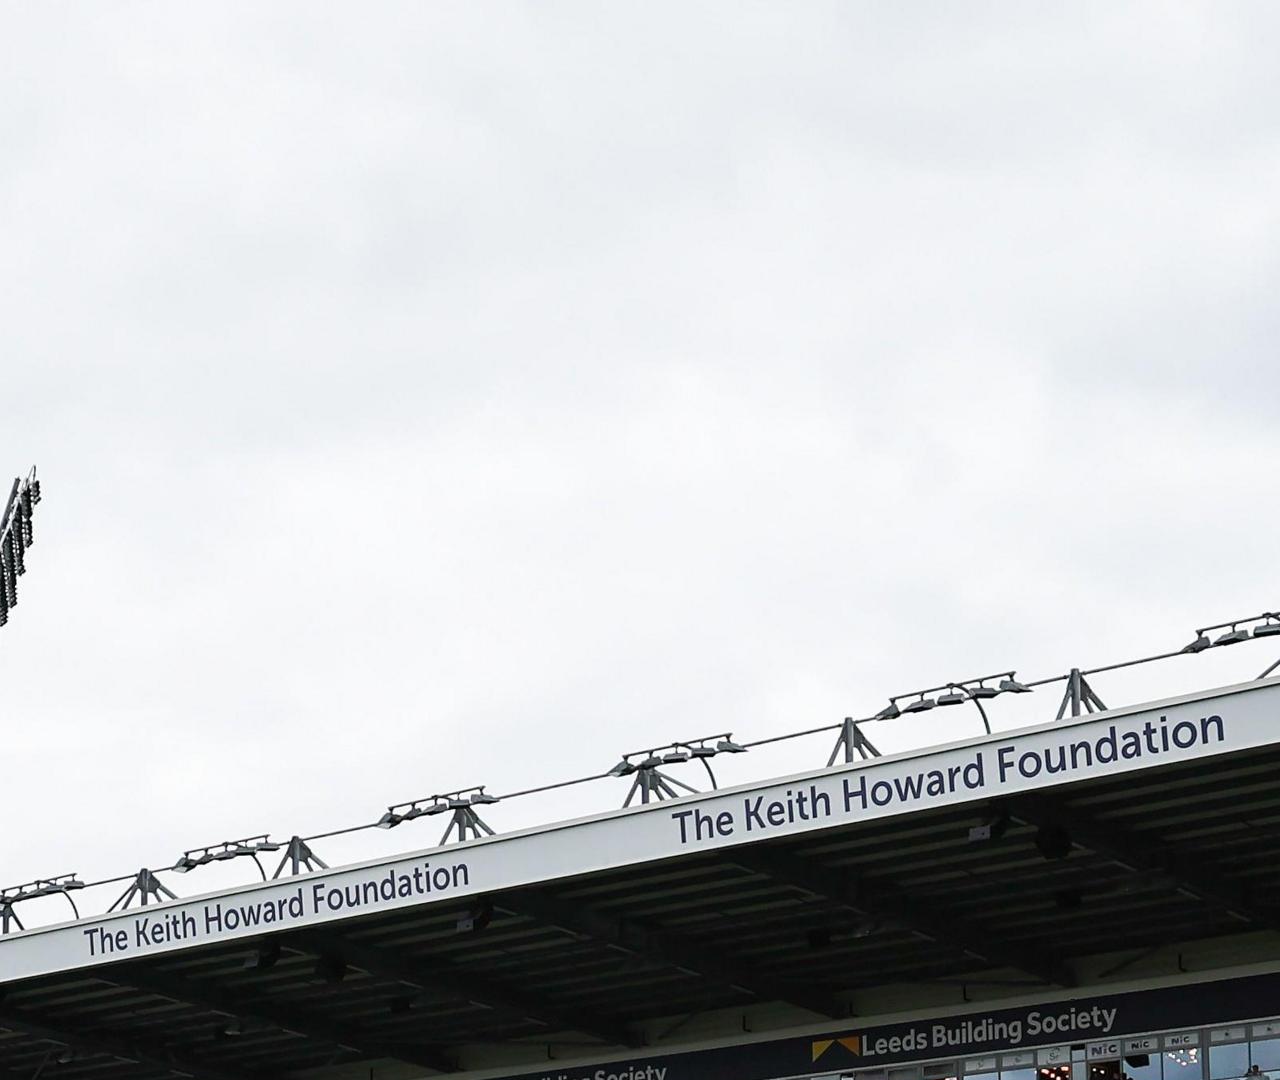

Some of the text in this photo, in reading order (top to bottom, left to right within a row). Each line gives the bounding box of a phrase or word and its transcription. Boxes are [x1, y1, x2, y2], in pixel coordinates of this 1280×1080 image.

[672, 714, 1225, 844] The Keith Howard Foundation
[84, 862, 469, 956] The Keith Howard Foundation
[862, 1006, 1117, 1057] Leeds Building Society
